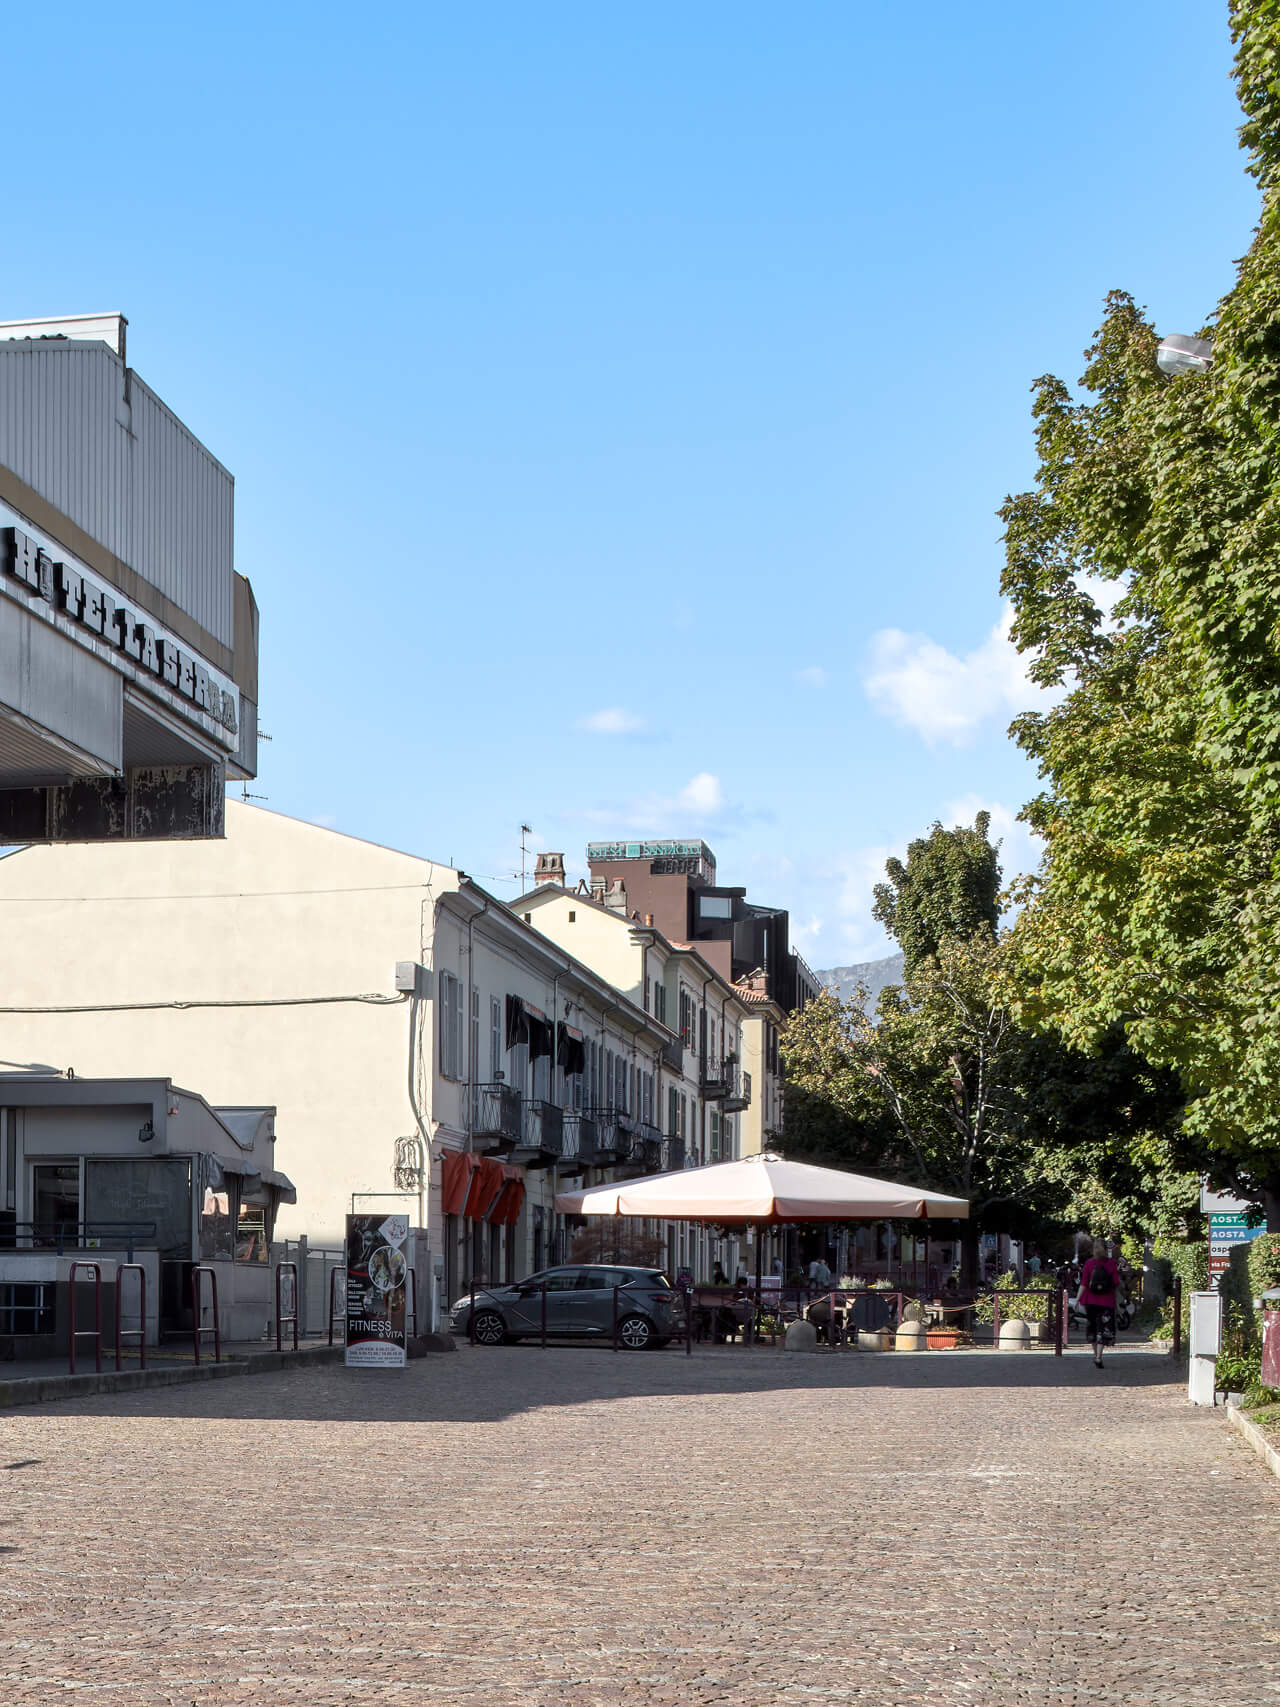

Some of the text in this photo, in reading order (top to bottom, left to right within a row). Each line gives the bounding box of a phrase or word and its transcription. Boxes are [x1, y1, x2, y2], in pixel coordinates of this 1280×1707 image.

[117, 608, 160, 675] LA
[157, 639, 238, 735] SERRA
[349, 1319, 392, 1332] FITNESS
